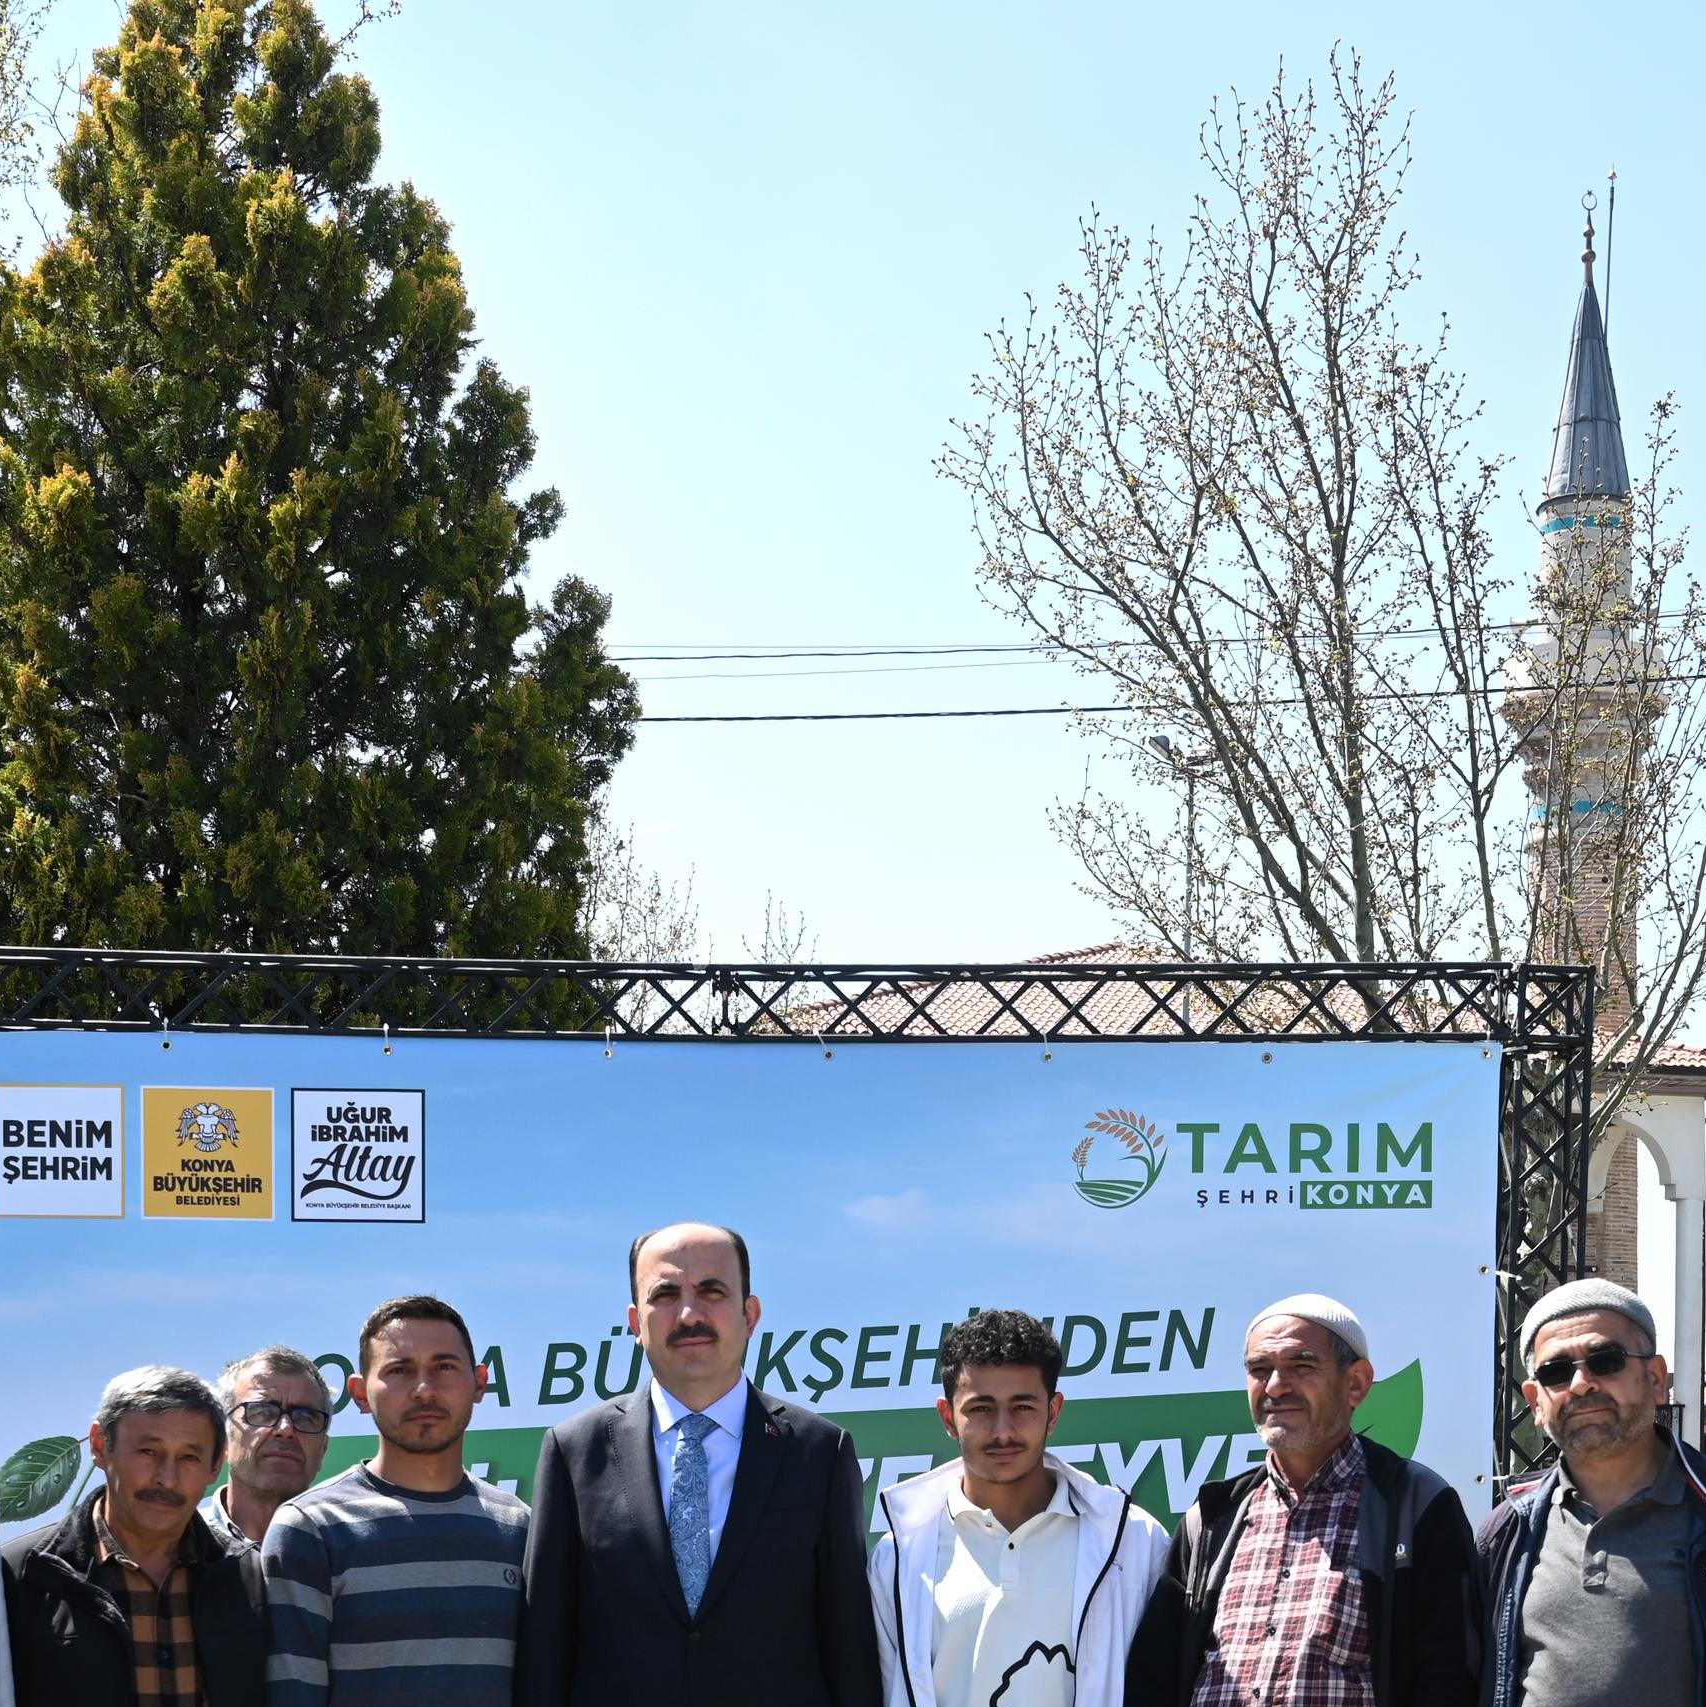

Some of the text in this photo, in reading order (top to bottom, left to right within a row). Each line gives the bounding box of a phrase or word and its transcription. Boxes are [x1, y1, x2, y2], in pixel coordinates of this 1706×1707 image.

[326, 1101, 392, 1124] UĞUR
[1176, 1121, 1433, 1174] TARIM
[181, 1158, 235, 1173] KONYA
[301, 1143, 416, 1200] Altay
[153, 1173, 263, 1195] BÜYÜKŞEHİR
[175, 1194, 241, 1207] BELEDİYESİ
[1196, 1184, 1427, 1209] ŞEHRİ KONYA
